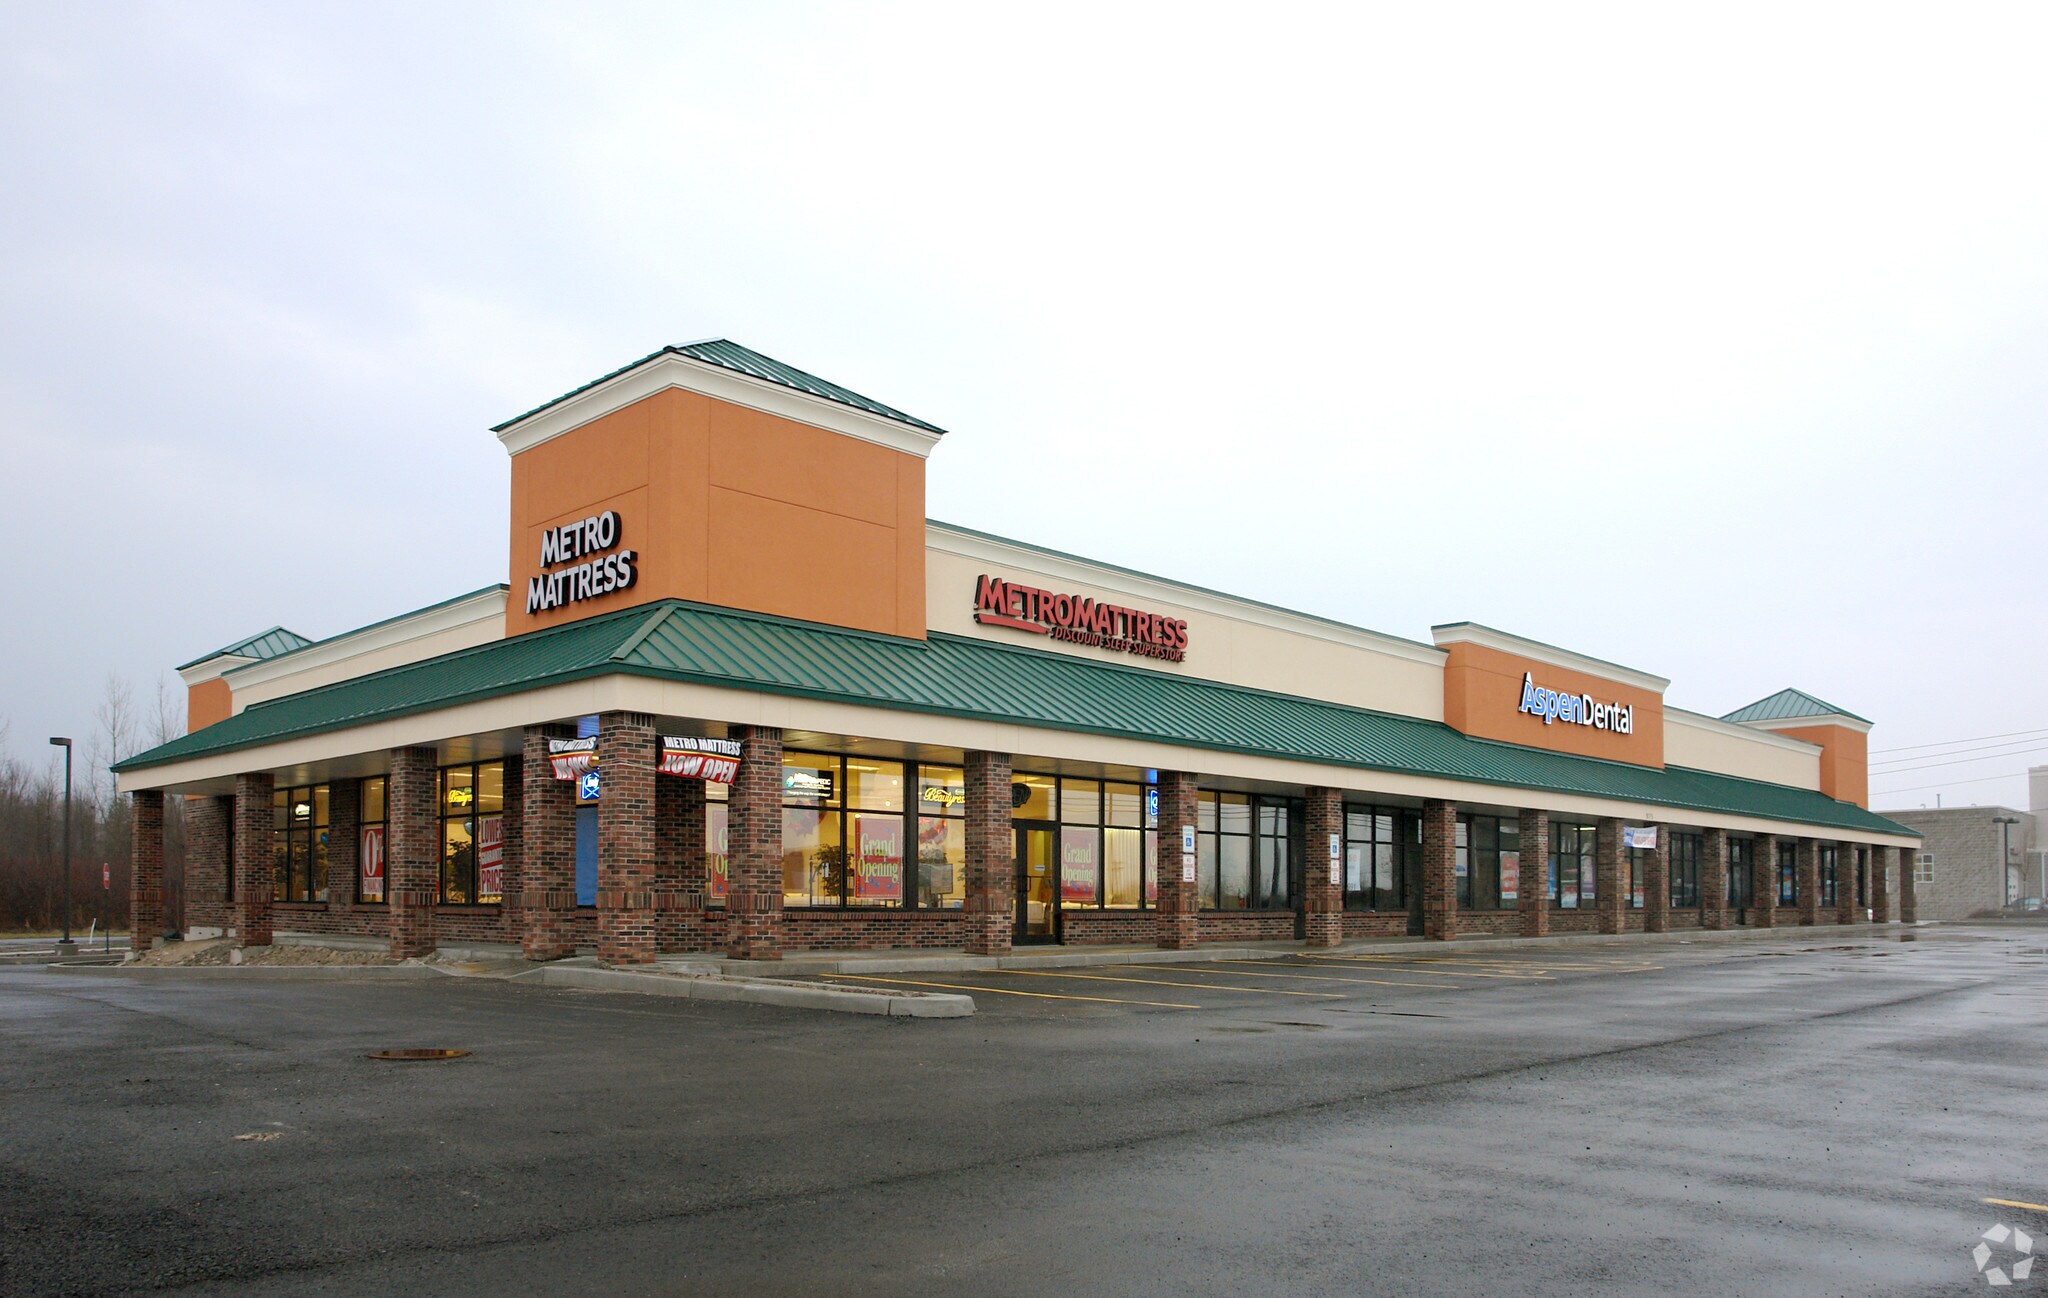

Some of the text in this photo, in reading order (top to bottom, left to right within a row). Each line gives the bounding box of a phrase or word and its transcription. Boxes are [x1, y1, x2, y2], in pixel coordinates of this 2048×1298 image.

[540, 510, 620, 568] METRO
[526, 550, 637, 614] MATTRESS
[974, 574, 1188, 649] METROMATTRESS
[1053, 626, 1186, 662] DISCOUNT SLEEP SUPERSTORE
[1520, 671, 1633, 735] AspenDental
[663, 736, 741, 756] METRO MATTRESS
[659, 754, 738, 783] NOW OPEN
[923, 787, 966, 807] Beautyres
[481, 818, 503, 844] LOWES
[860, 832, 895, 857] Grand
[1064, 844, 1092, 863] Grand
[857, 857, 899, 883] Opening
[1061, 864, 1094, 886] Opening
